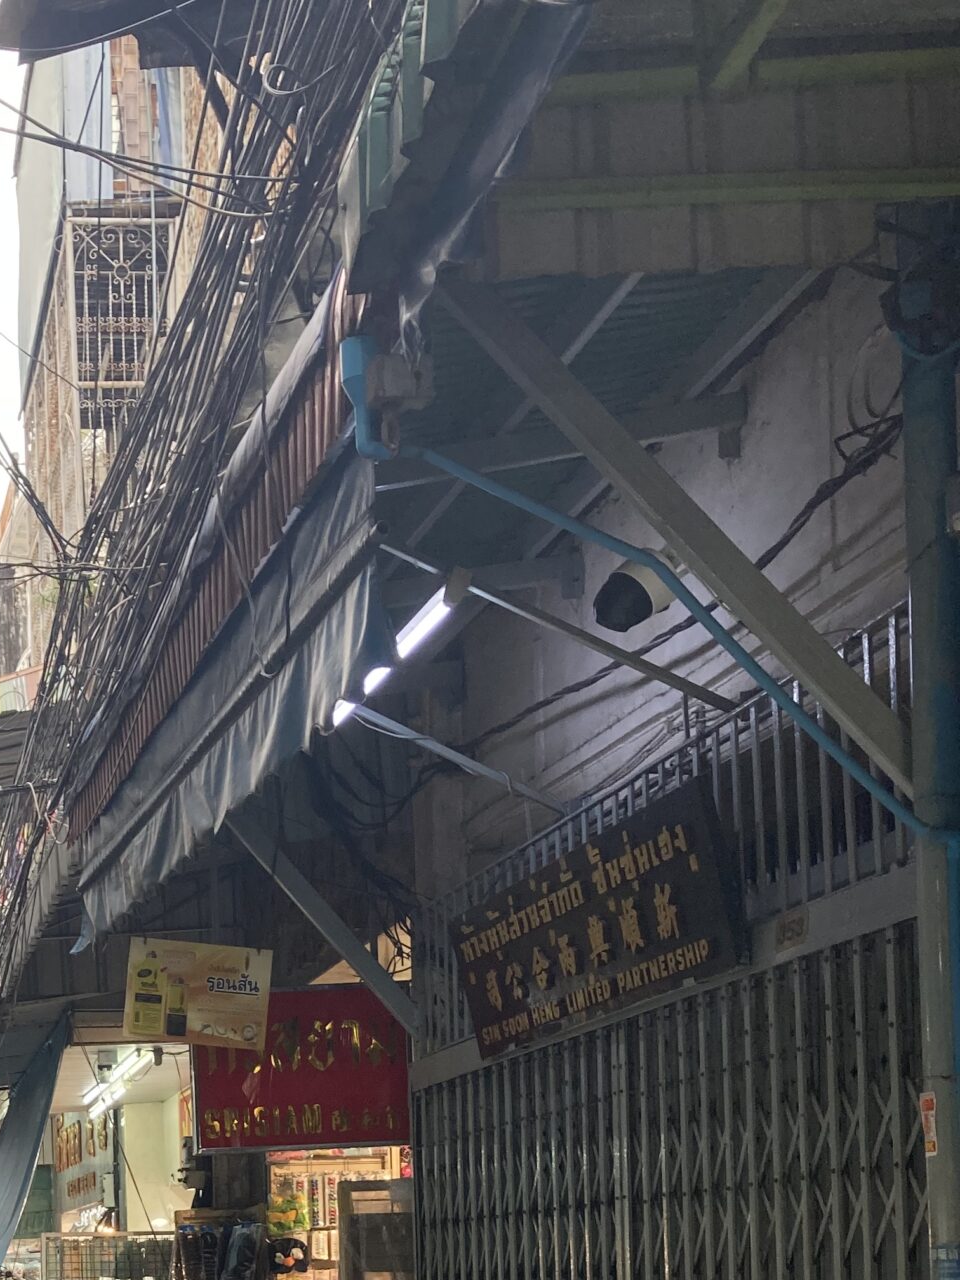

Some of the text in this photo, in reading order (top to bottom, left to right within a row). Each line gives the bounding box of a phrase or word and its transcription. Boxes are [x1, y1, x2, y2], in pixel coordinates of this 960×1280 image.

[503, 1012, 530, 1037] SOON
[532, 1002, 560, 1027] HENG
[566, 980, 611, 1012] LIMITED
[617, 938, 710, 994] PARTNERSHIP
